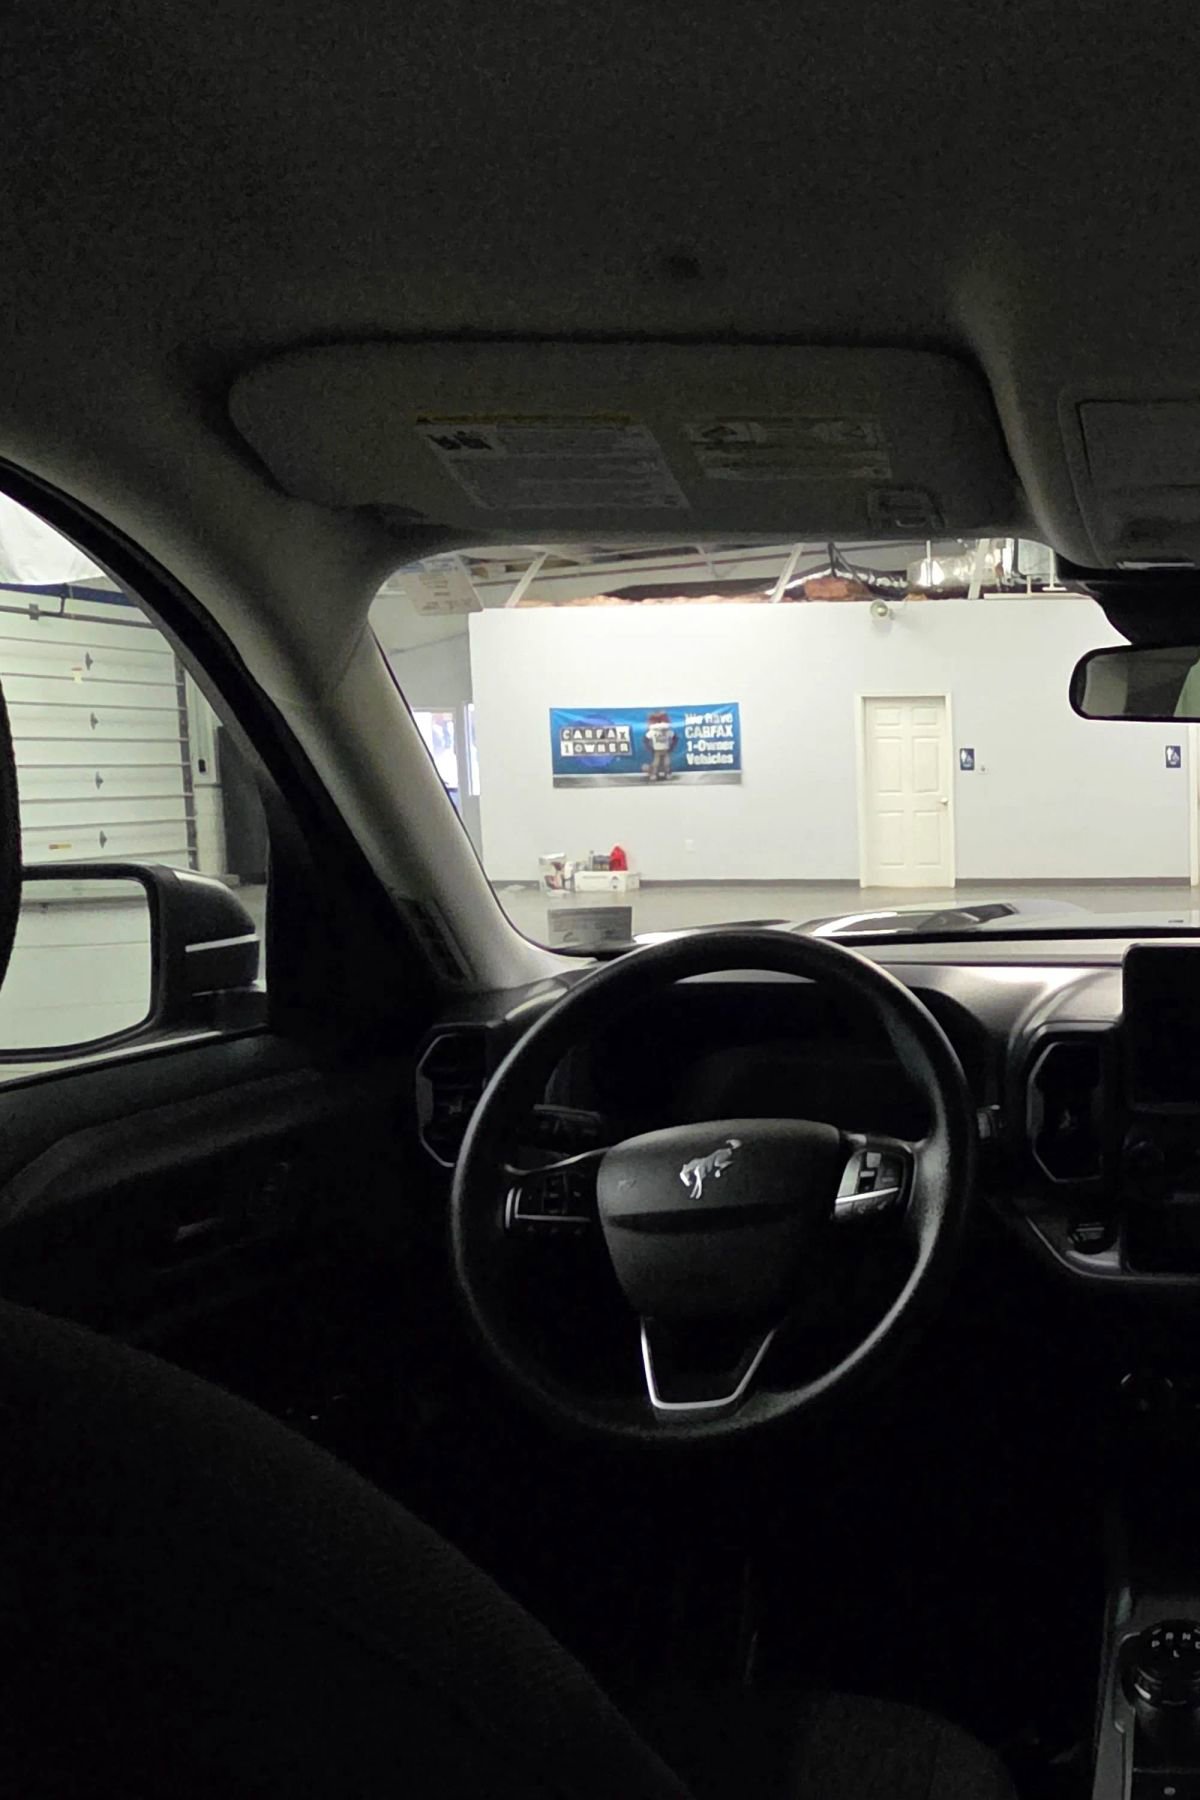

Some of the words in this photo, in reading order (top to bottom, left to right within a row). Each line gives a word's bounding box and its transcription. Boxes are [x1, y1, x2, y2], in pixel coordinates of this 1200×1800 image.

[562, 728, 628, 740] CARFAX
[685, 724, 734, 739] CARFAX
[574, 743, 629, 754] OWNER
[686, 739, 735, 752] 1-Owner
[686, 752, 734, 765] Vehicles
[1151, 1640, 1160, 1648] P
[1165, 1631, 1174, 1640] R
[1182, 1631, 1191, 1640] N
